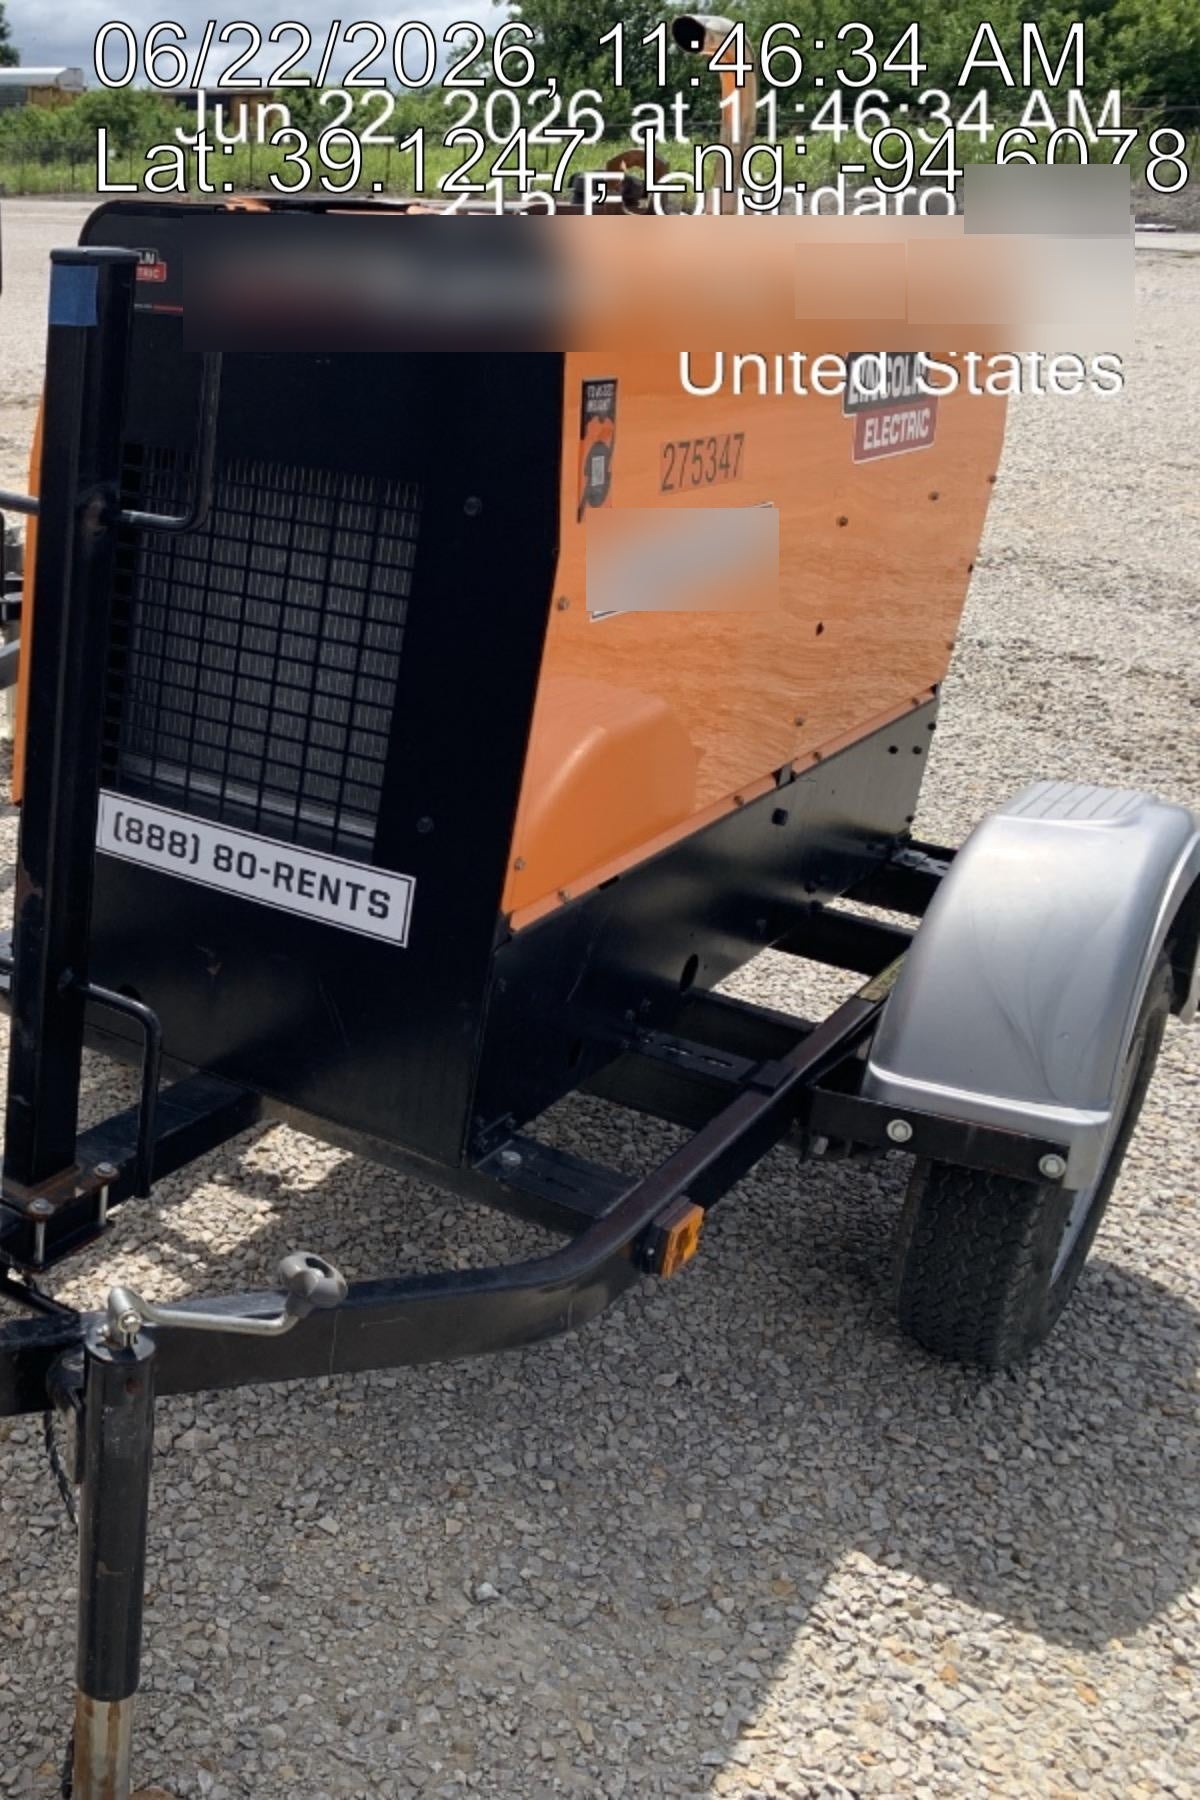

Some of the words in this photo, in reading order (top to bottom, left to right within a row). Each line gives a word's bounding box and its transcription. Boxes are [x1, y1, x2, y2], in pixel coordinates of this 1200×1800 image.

[863, 407, 931, 450] ELECTRIC
[661, 432, 745, 491] 275347
[112, 810, 199, 865] (888)
[212, 843, 391, 920] 80-RENTS
